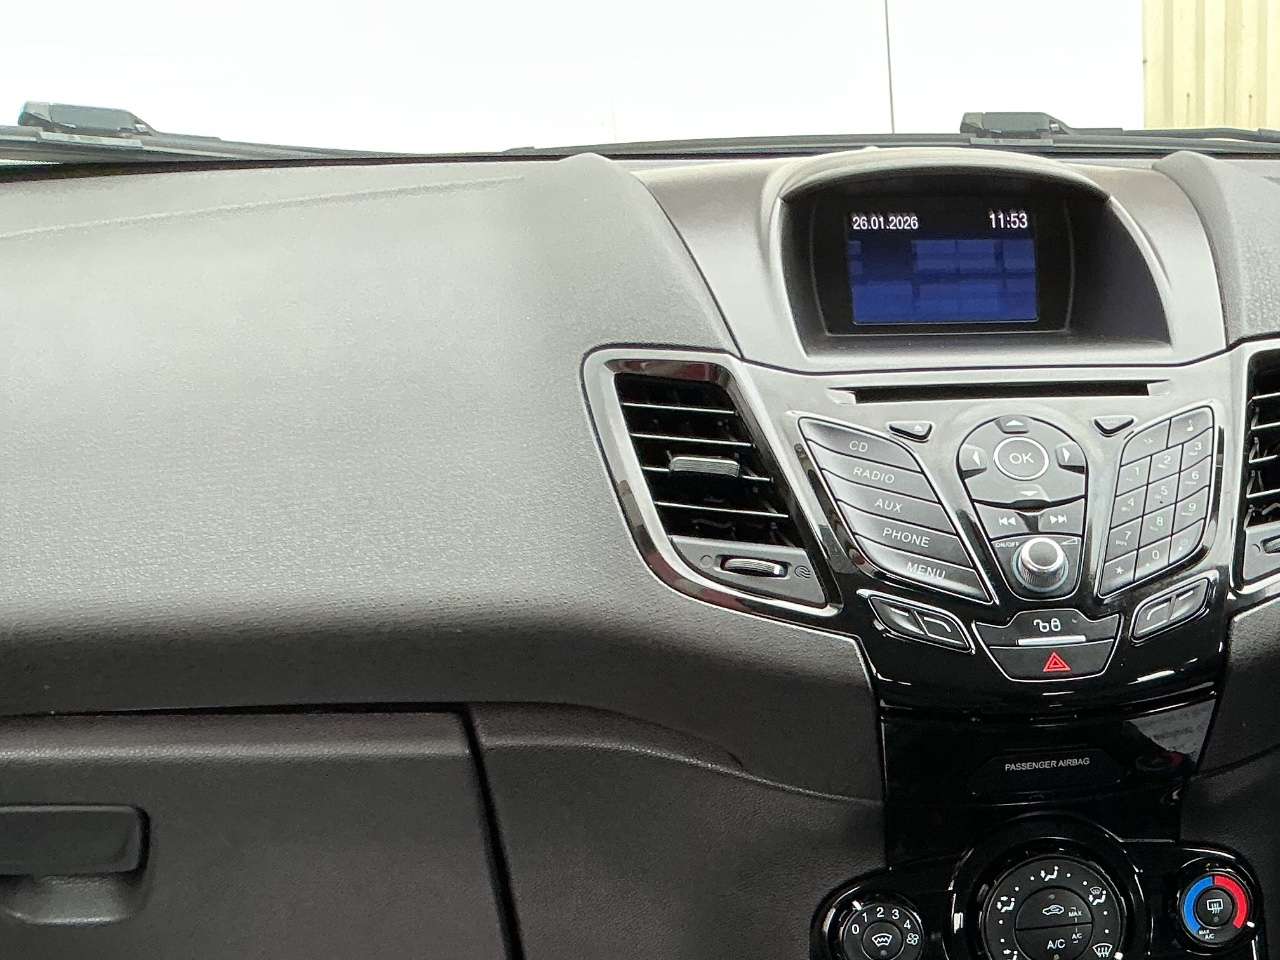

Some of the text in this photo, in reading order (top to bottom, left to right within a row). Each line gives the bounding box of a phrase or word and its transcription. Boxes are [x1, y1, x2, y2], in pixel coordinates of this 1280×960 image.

[852, 215, 919, 230] 26.01.2026
[989, 213, 1028, 229] 11:53
[849, 440, 869, 453] CD
[1194, 441, 1202, 451] 3
[1008, 452, 1034, 465] OK
[1163, 455, 1171, 464] 2
[853, 466, 895, 484] RADIO
[1191, 470, 1200, 480] 6
[1160, 486, 1168, 495] 5
[874, 498, 903, 513] AUX
[1188, 502, 1197, 512] 9
[1156, 516, 1164, 527] 8
[882, 527, 931, 548] PHONE
[1124, 530, 1132, 540] 7
[1152, 550, 1159, 560] 0
[906, 561, 946, 579] MENU
[1005, 757, 1091, 772] PASSENGER AIRBAG
[861, 911, 868, 923] 1
[876, 906, 885, 918] 2
[891, 908, 900, 920] 3
[851, 923, 860, 935] 0
[903, 919, 912, 930] 4
[1047, 938, 1066, 951] A/C
